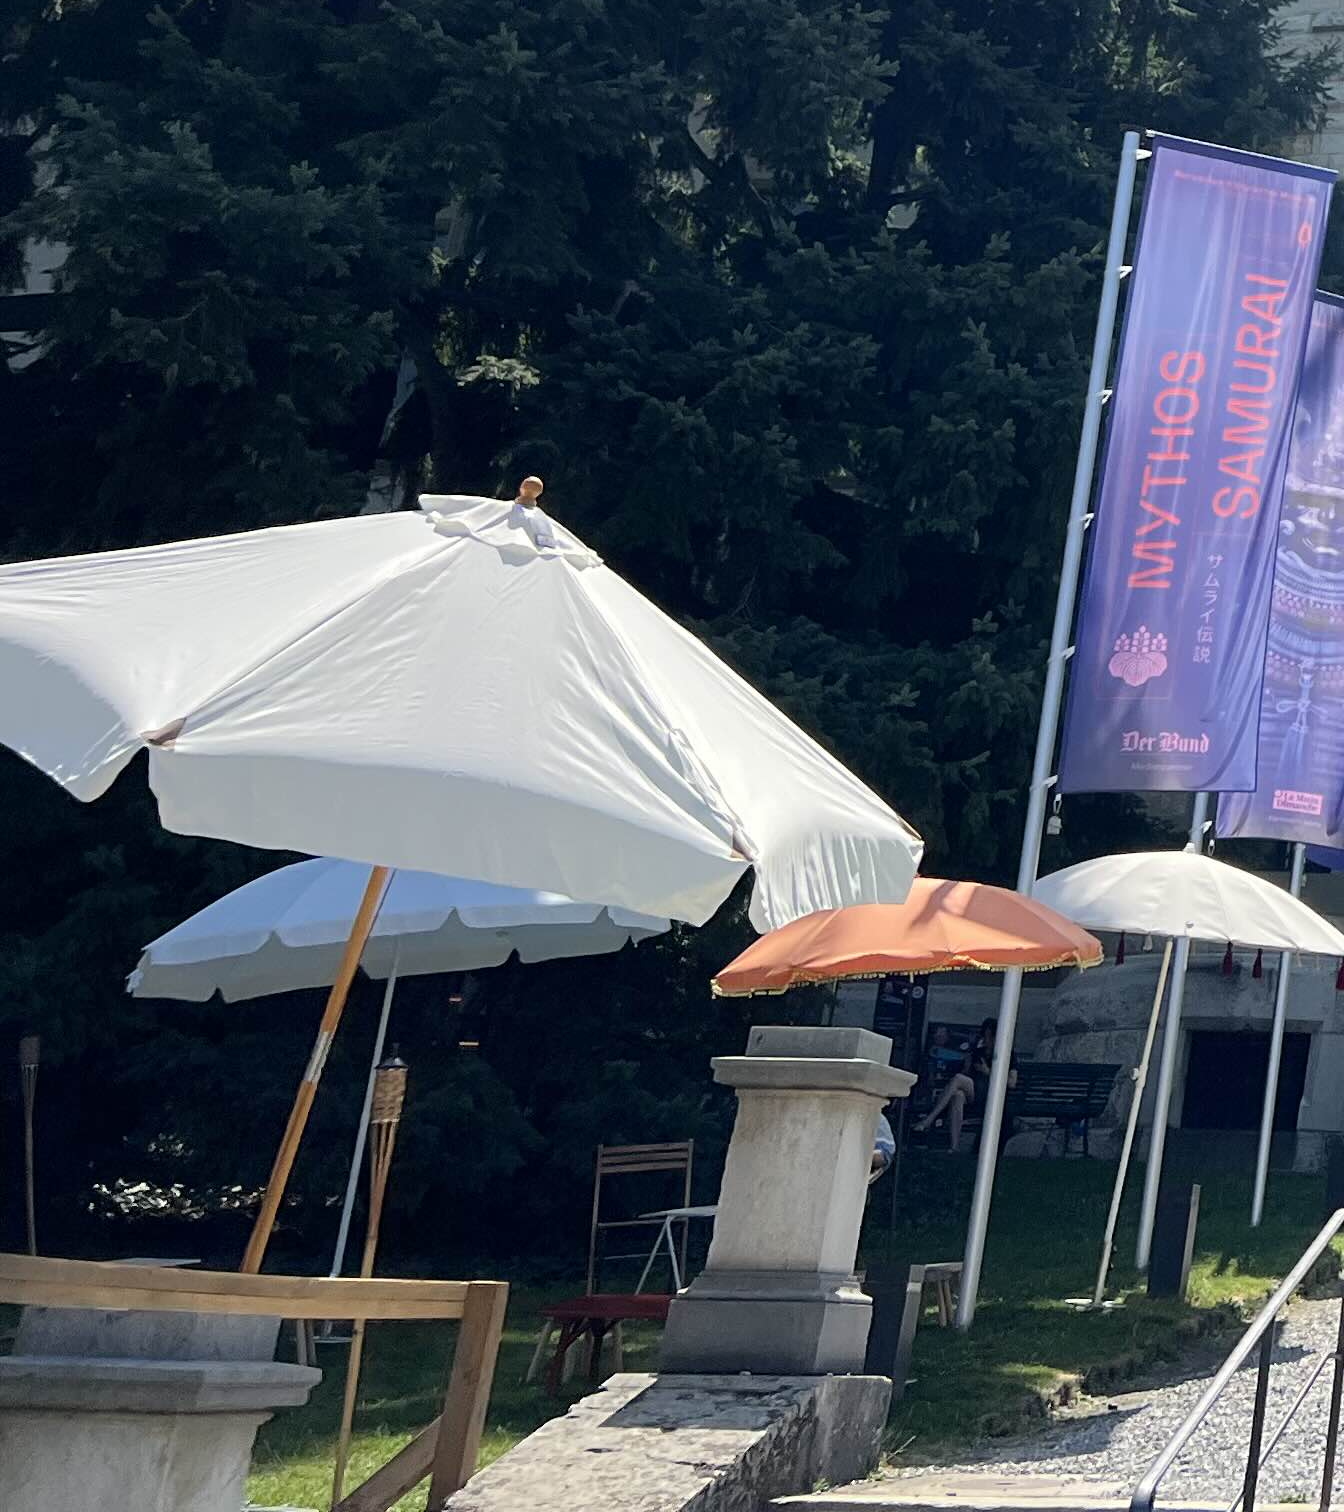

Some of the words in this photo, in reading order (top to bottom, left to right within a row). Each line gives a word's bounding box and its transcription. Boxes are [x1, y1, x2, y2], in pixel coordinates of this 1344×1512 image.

[1128, 350, 1206, 588] MYTHOS
[1212, 274, 1288, 519] SAMURAI
[1192, 553, 1224, 664] サムライ伝説
[1120, 730, 1155, 752] Der
[1158, 731, 1211, 754] Bund
